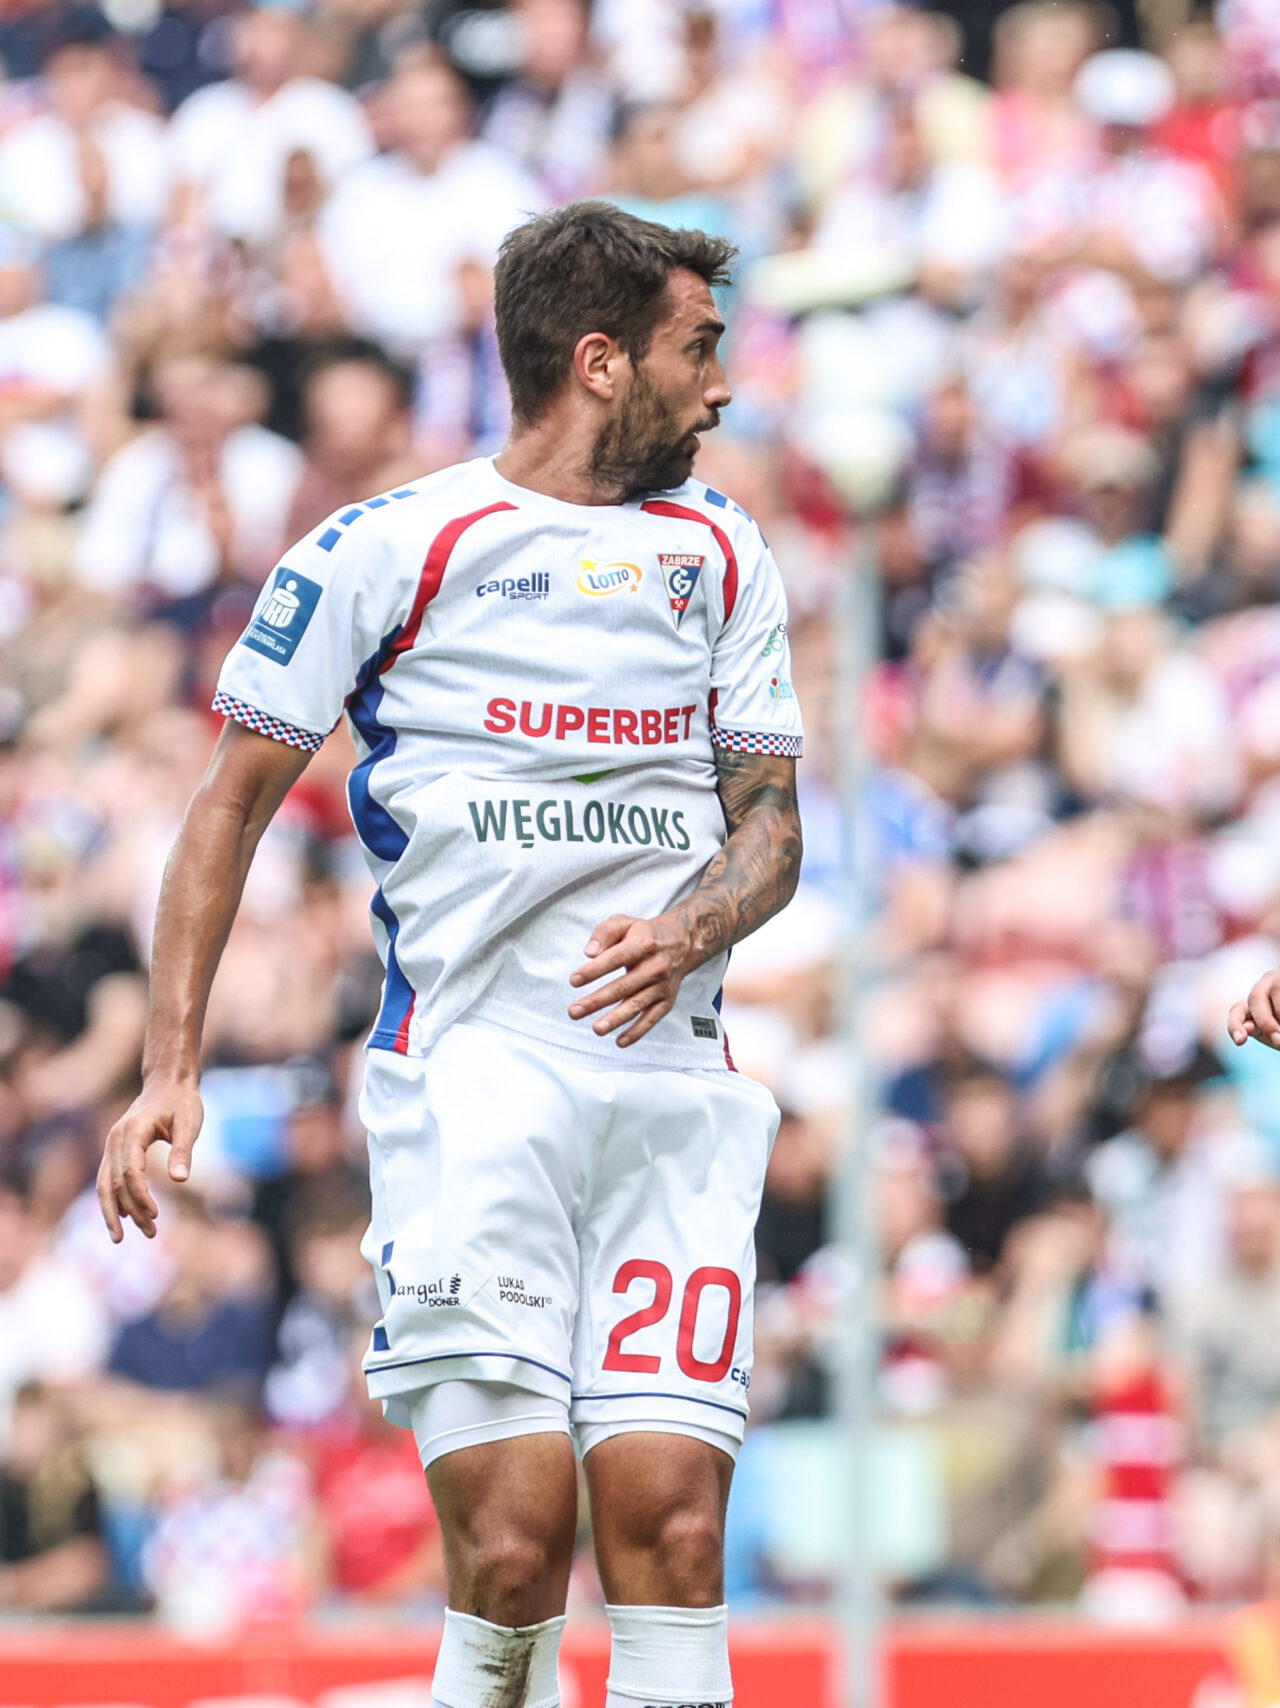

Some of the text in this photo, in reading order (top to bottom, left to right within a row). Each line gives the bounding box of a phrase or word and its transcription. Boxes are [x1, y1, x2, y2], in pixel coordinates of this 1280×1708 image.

[661, 555, 701, 566] ZABRZE
[476, 573, 550, 597] capelli
[587, 569, 630, 590] LOTTO
[509, 592, 549, 600] SPORT
[484, 698, 697, 745] SUPERBET
[468, 800, 691, 850] WĘGLOKOKS
[397, 1278, 444, 1304] angal
[498, 1276, 525, 1291] LUKAS
[428, 1294, 461, 1307] DÖNER
[602, 1259, 742, 1383] 20
